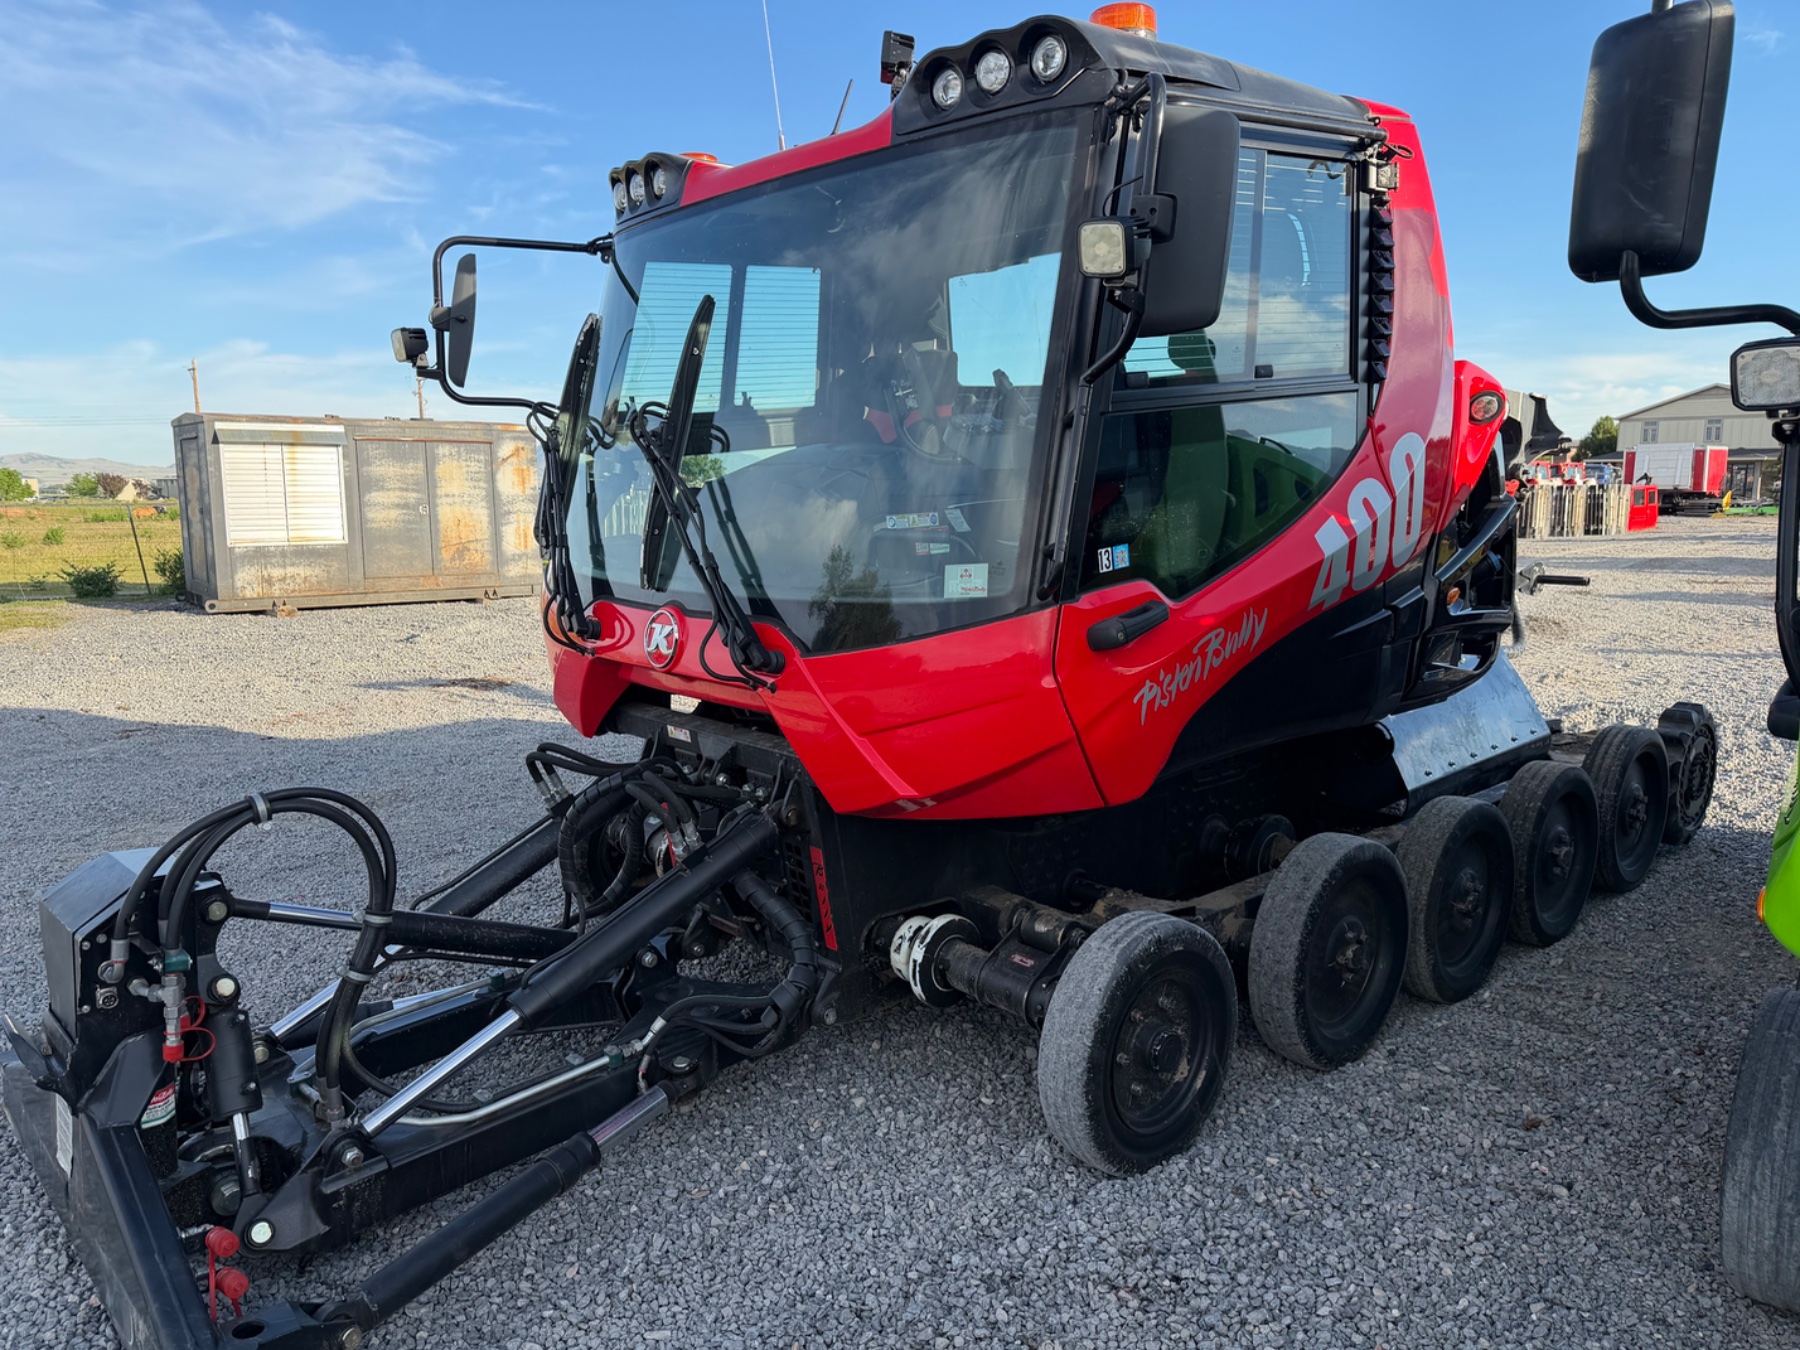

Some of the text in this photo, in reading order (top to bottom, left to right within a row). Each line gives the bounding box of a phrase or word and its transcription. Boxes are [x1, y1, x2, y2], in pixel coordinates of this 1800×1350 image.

[1308, 432, 1426, 610] 400
[1098, 549, 1112, 572] 13
[647, 622, 677, 656] K
[1132, 606, 1268, 726] PistenBully
